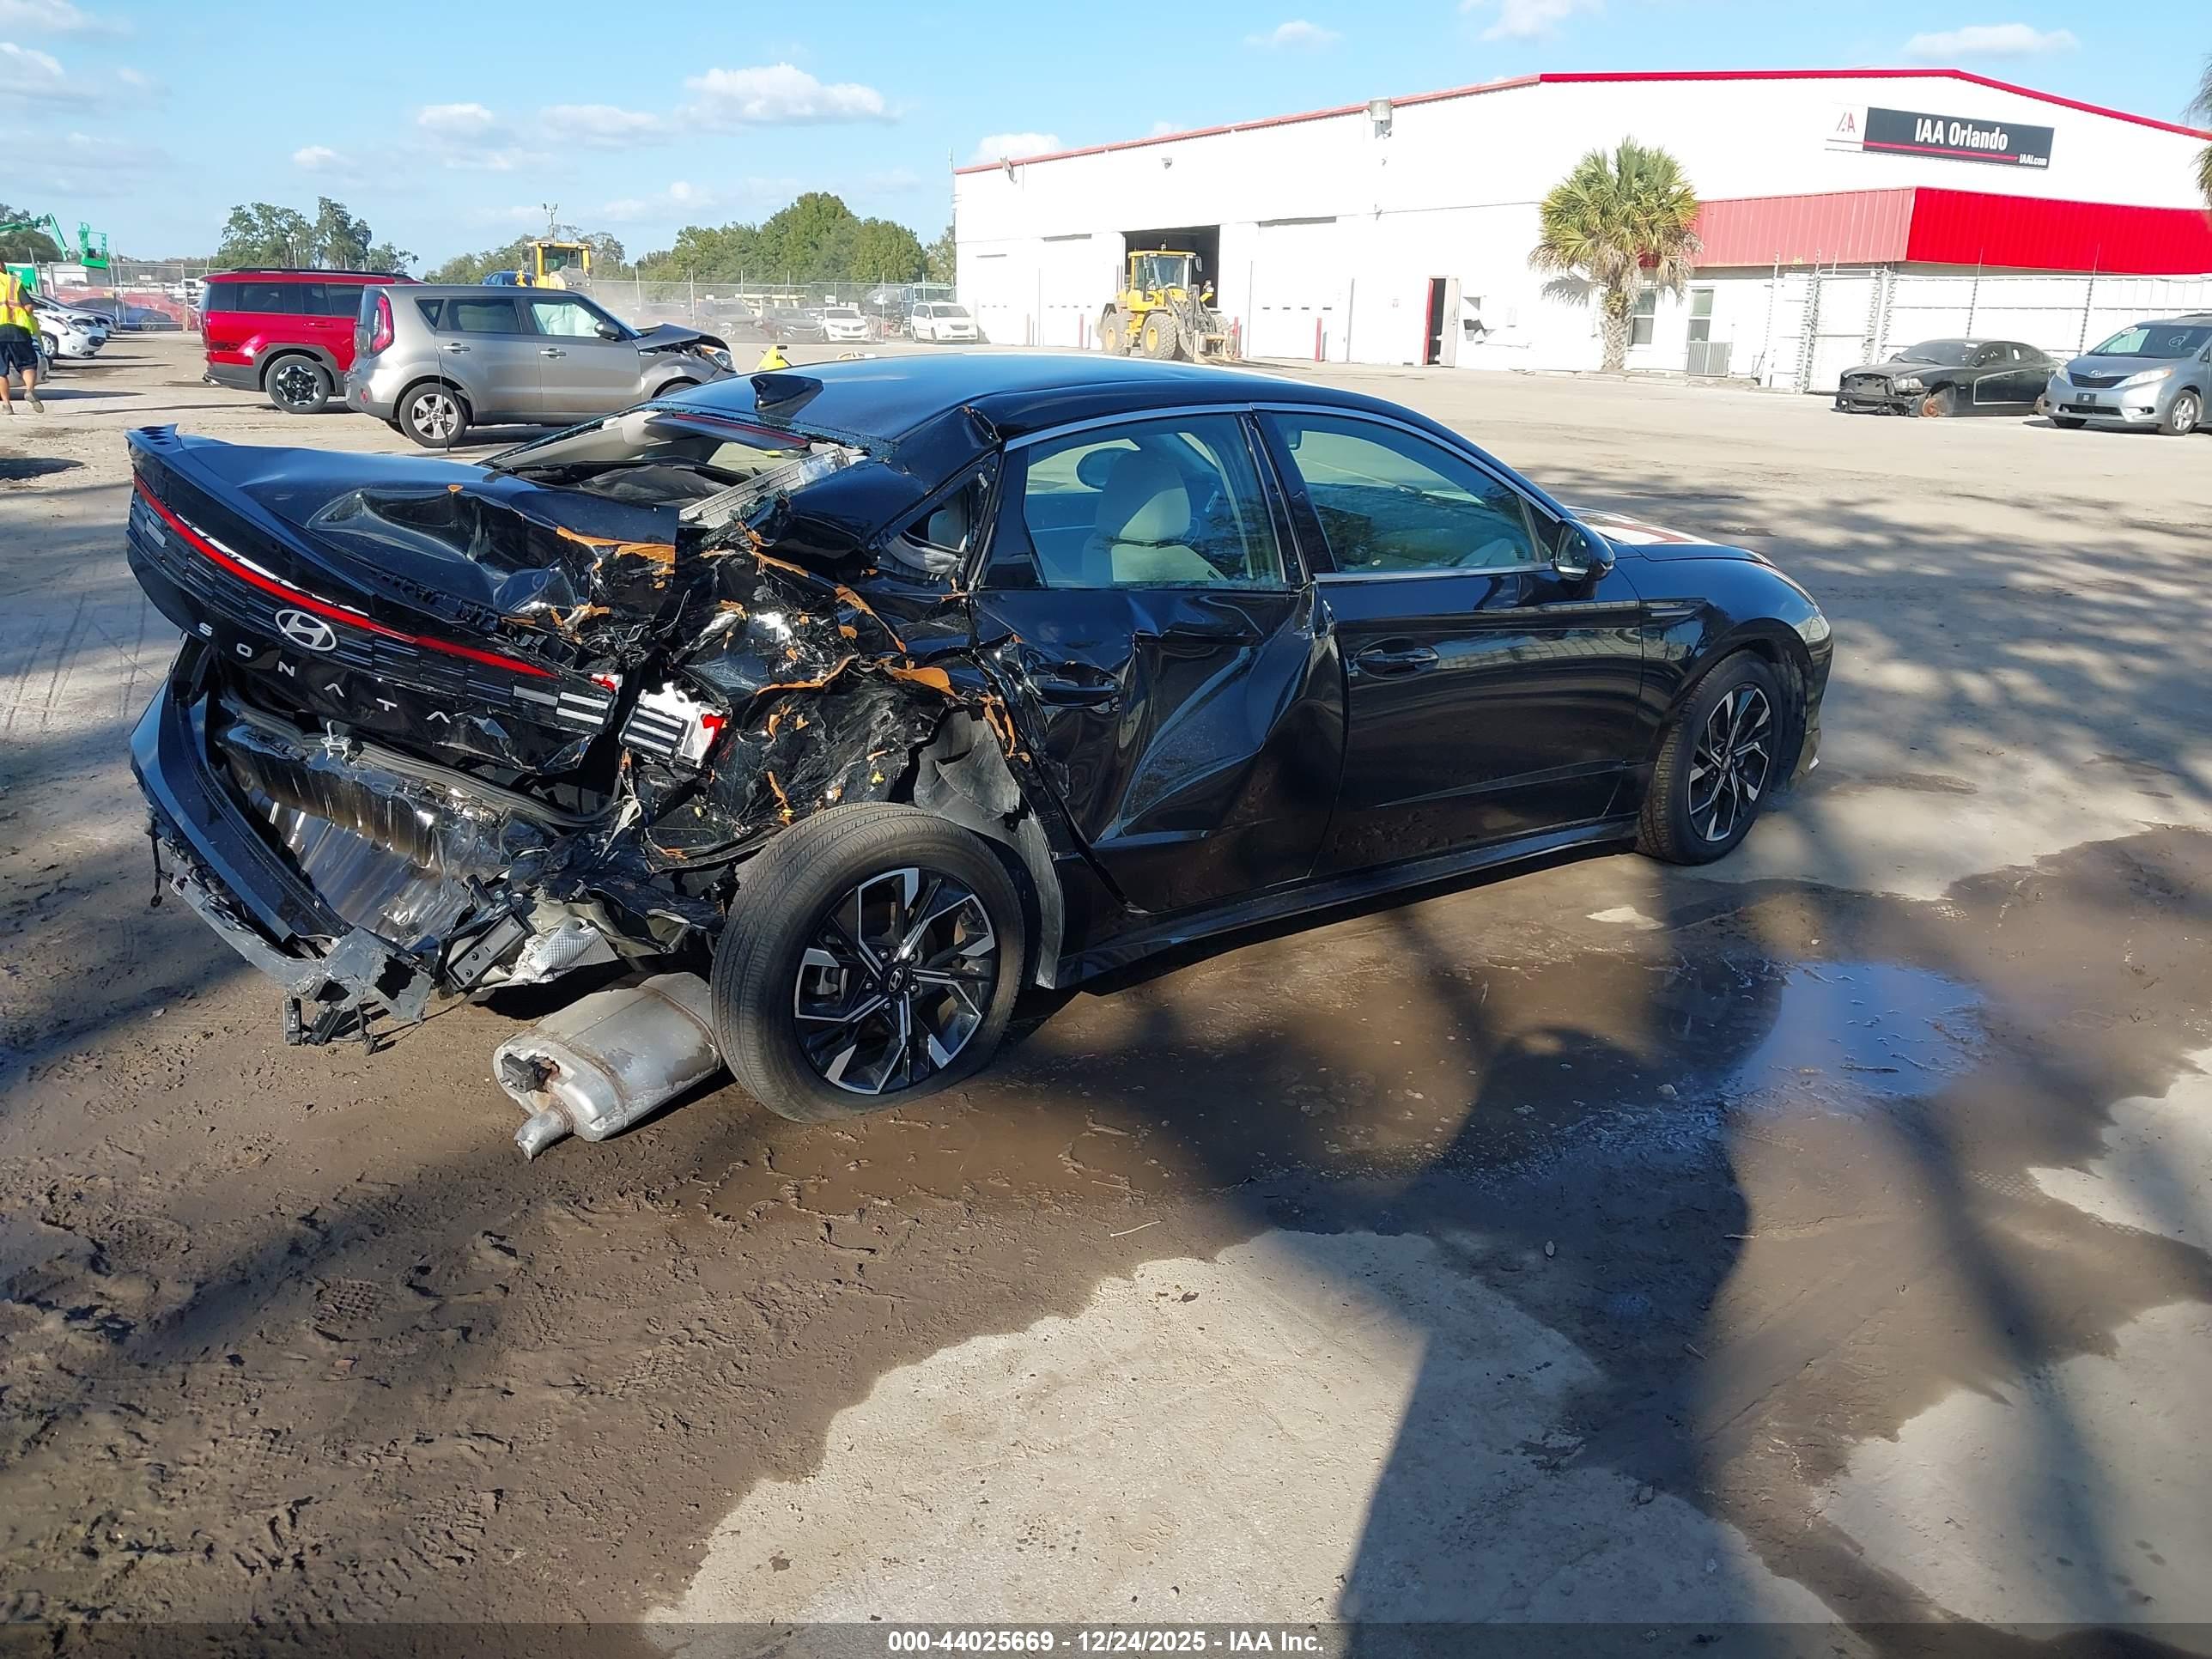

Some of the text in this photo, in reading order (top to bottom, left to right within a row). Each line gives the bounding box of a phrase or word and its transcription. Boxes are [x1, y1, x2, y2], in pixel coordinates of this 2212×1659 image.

[1915, 118, 2008, 151] IAA Orlando
[198, 622, 451, 724] SONATA
